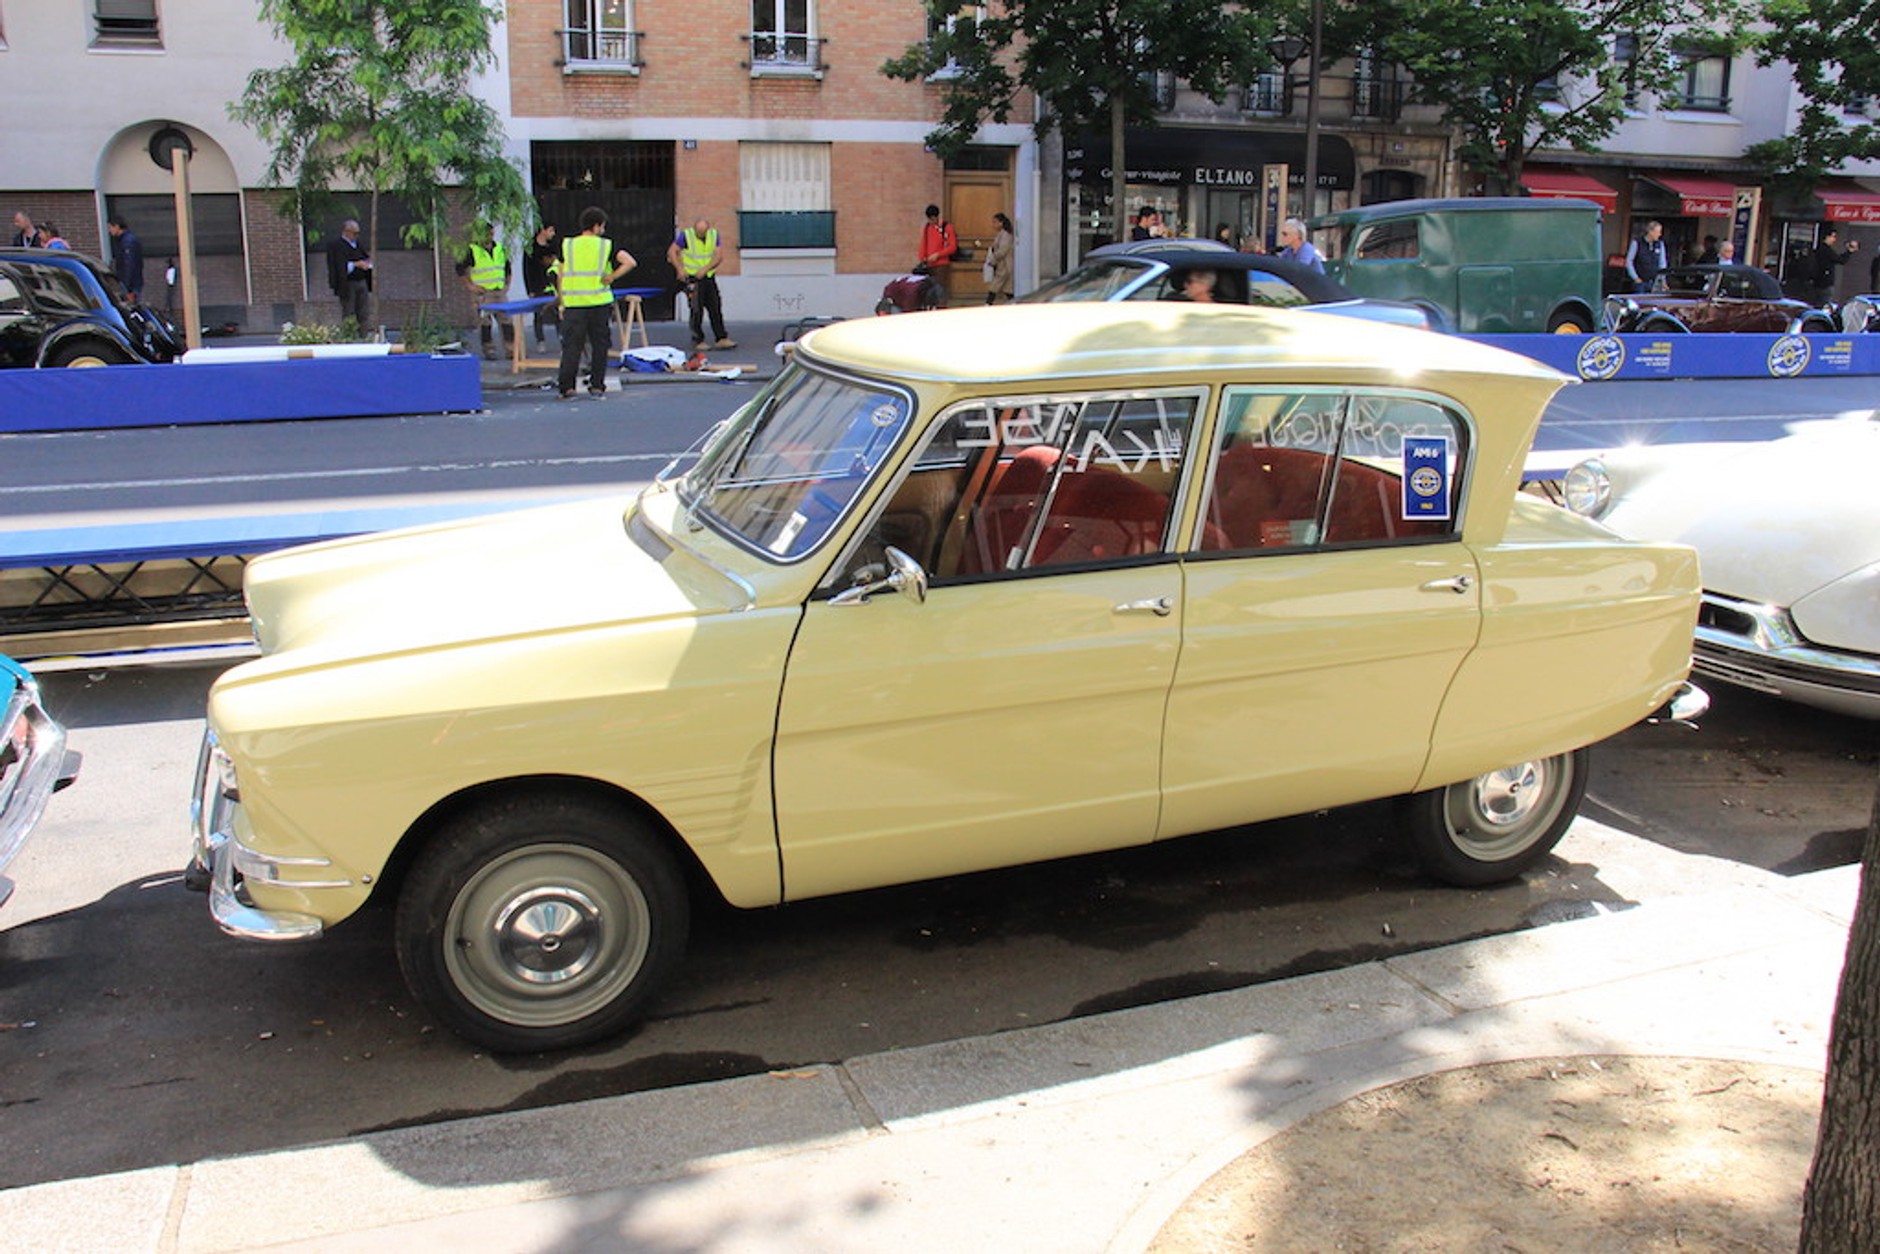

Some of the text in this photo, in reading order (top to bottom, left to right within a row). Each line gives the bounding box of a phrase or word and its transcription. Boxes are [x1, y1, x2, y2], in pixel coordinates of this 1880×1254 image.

[1195, 168, 1254, 185] ELIANO
[1413, 447, 1440, 458] AMI 6
